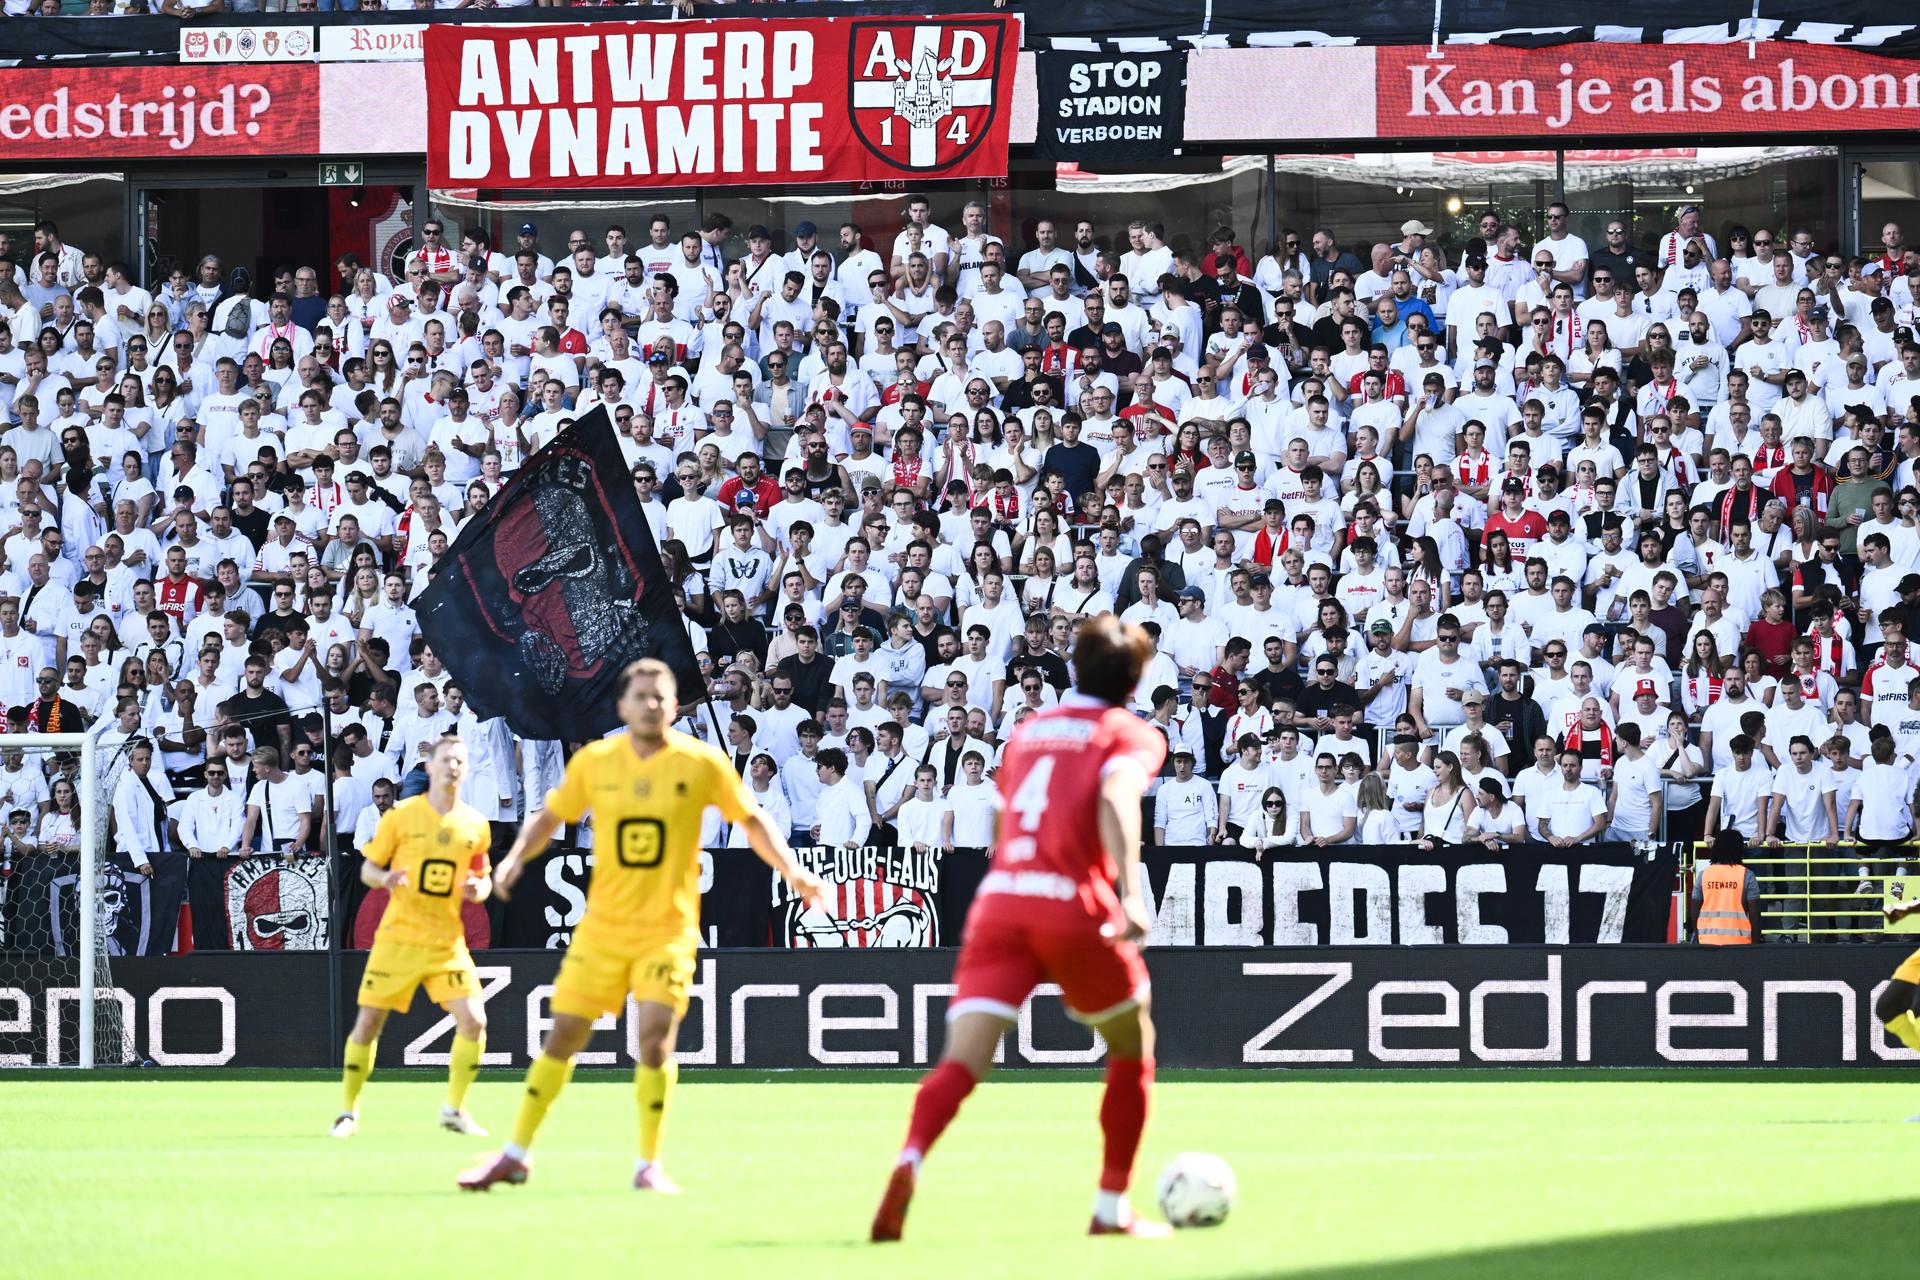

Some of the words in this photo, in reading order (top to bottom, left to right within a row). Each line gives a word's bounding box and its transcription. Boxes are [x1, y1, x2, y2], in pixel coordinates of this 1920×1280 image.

[350, 28, 425, 54] Royal
[459, 30, 815, 106] ANTWERP
[1070, 61, 1162, 95] STOP
[1058, 95, 1162, 118] STADION
[1406, 65, 1540, 118] Kan
[1546, 63, 1613, 129] je
[1631, 60, 1722, 114] als
[449, 102, 824, 179] DYNAMITE
[1056, 125, 1163, 144] VERBODEN
[1010, 755, 1056, 833] 4
[231, 852, 325, 889] AMBEES
[1707, 880, 1738, 890] STEWARD
[1535, 863, 1635, 944] 17
